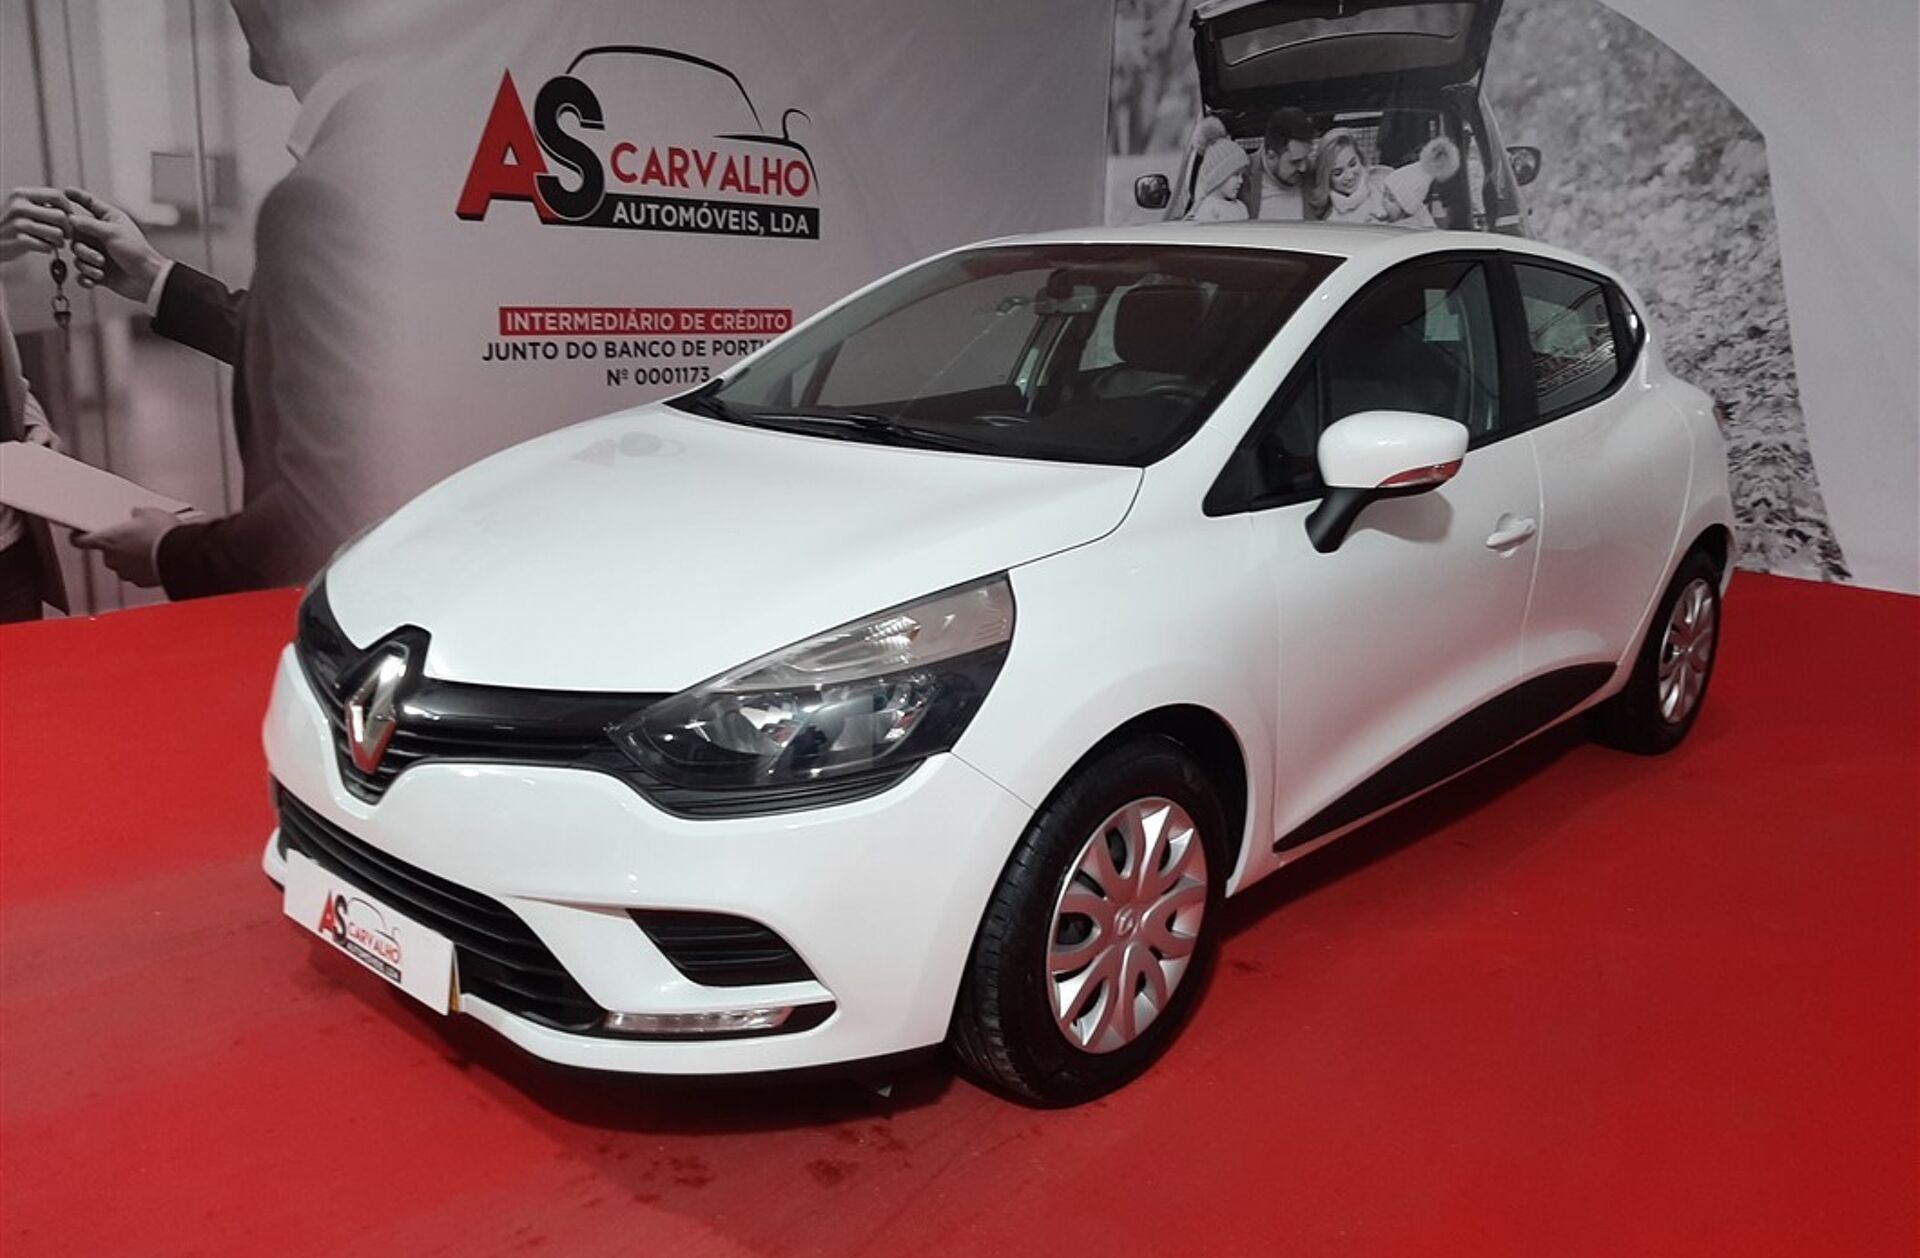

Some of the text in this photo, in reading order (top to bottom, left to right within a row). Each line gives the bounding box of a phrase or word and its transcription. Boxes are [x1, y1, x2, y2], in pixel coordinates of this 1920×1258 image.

[455, 67, 811, 225] AS CARVALHO
[612, 202, 810, 236] AUTOMÓVEIS, LDA
[506, 309, 787, 332] INTERMEDIÁRIO DE CRÉDITO
[482, 341, 559, 361] JUNTO
[566, 341, 598, 359] DO
[604, 340, 676, 358] BANCO
[682, 340, 707, 357] DE
[607, 367, 710, 386] Nº 0001173
[319, 888, 348, 943] AS
